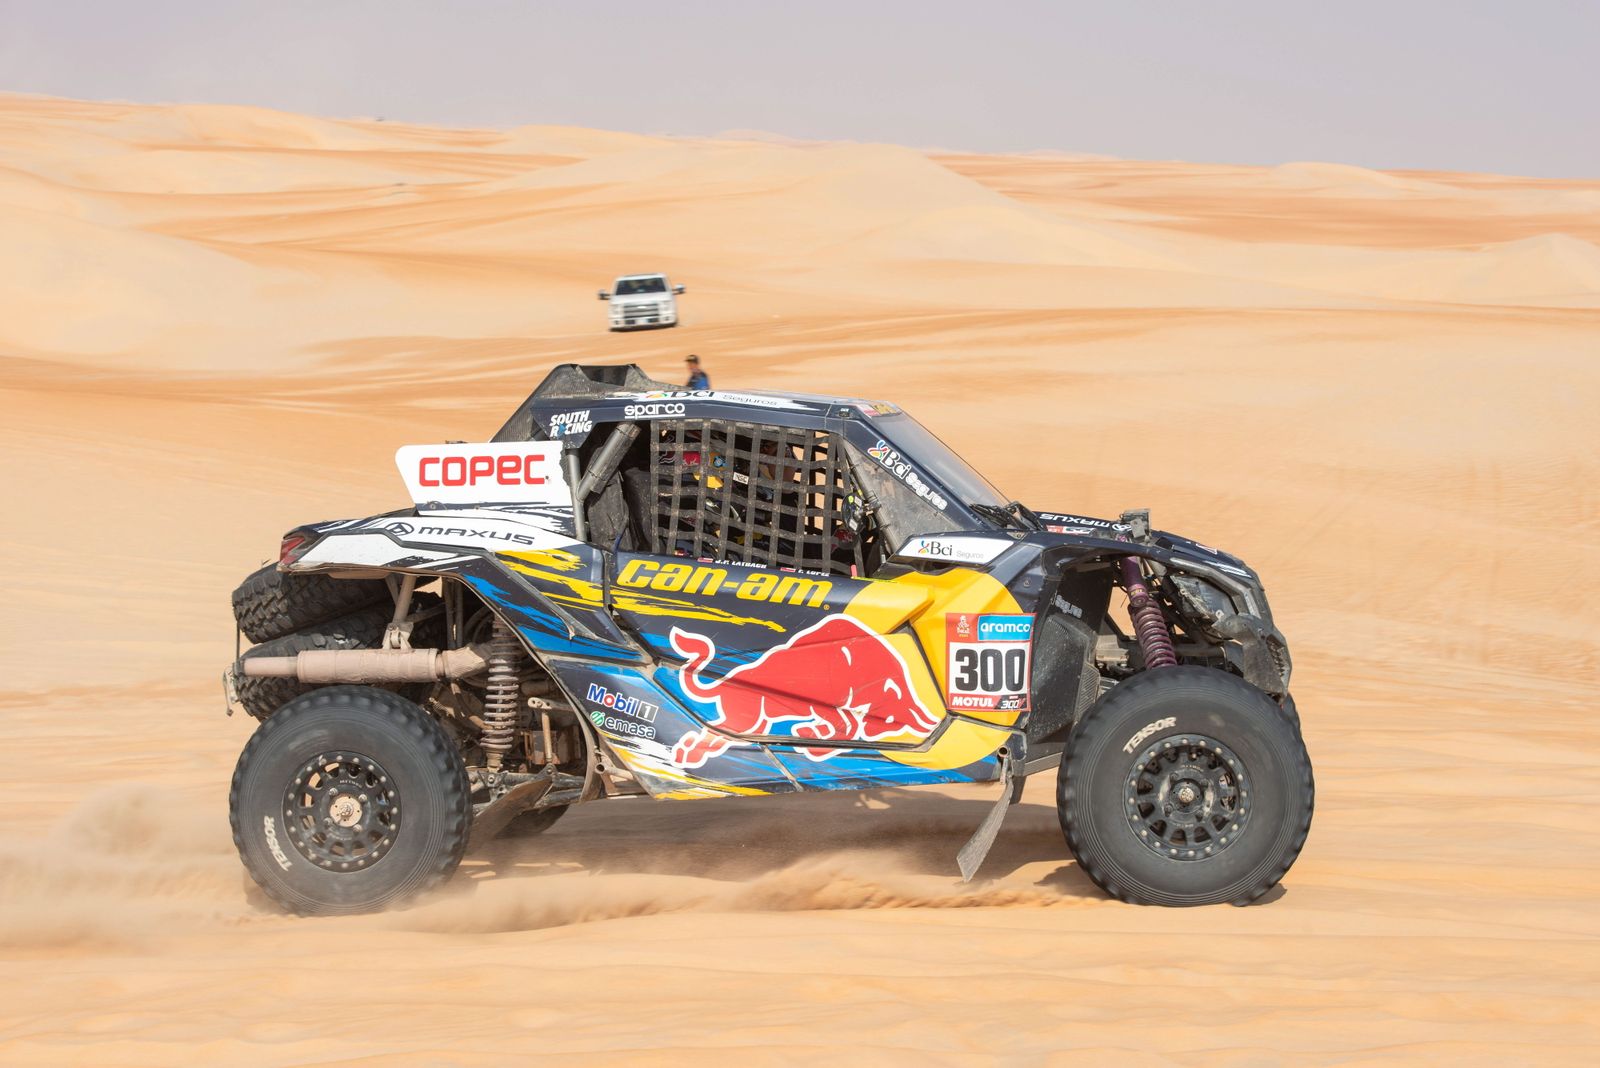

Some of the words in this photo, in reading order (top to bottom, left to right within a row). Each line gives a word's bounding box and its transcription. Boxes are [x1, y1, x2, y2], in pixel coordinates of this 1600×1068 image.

[549, 410, 591, 426] SOUTH
[624, 403, 685, 418] sparco
[880, 447, 911, 479] Bci
[1039, 512, 1110, 528] MAXUS
[418, 526, 535, 546] MAXUS
[930, 541, 953, 556] Bci
[956, 550, 984, 559] Seguros
[617, 559, 832, 608] can-am
[980, 623, 1031, 632] aramco
[955, 648, 1026, 692] 300
[586, 683, 639, 716] Mobil
[952, 696, 994, 707] MOTUL
[605, 716, 657, 739] emasa
[1122, 716, 1177, 754] TENSOR
